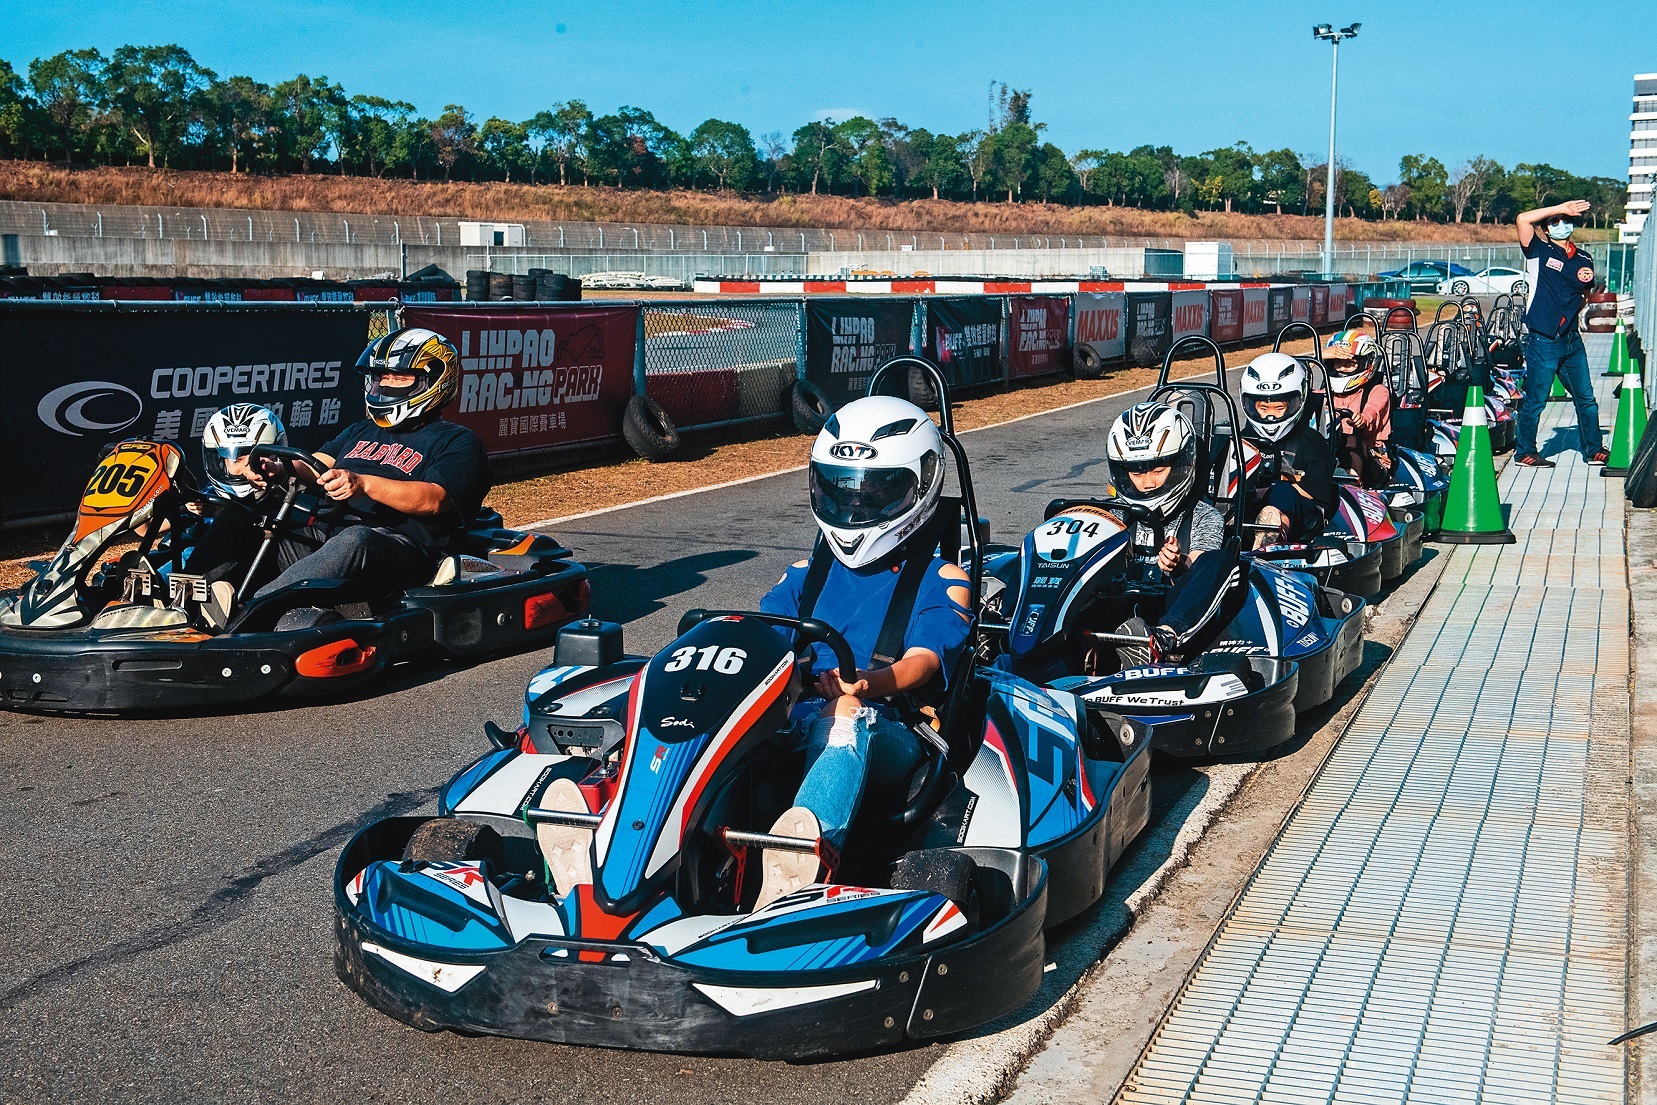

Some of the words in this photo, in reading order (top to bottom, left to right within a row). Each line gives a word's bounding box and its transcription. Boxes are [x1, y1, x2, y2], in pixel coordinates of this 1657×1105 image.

[1076, 308, 1119, 342] MAXXIS
[459, 369, 553, 414] RACING
[552, 364, 602, 405] PARK
[150, 397, 342, 441] 美國輪胎
[834, 445, 871, 458] KYT
[86, 463, 150, 498] 205
[1046, 519, 1100, 538] 304
[664, 645, 748, 675] 316
[1124, 667, 1189, 681] BUFF
[1127, 696, 1148, 704] We
[1149, 698, 1185, 706] Trust
[956, 796, 976, 843] SODIKART.COM
